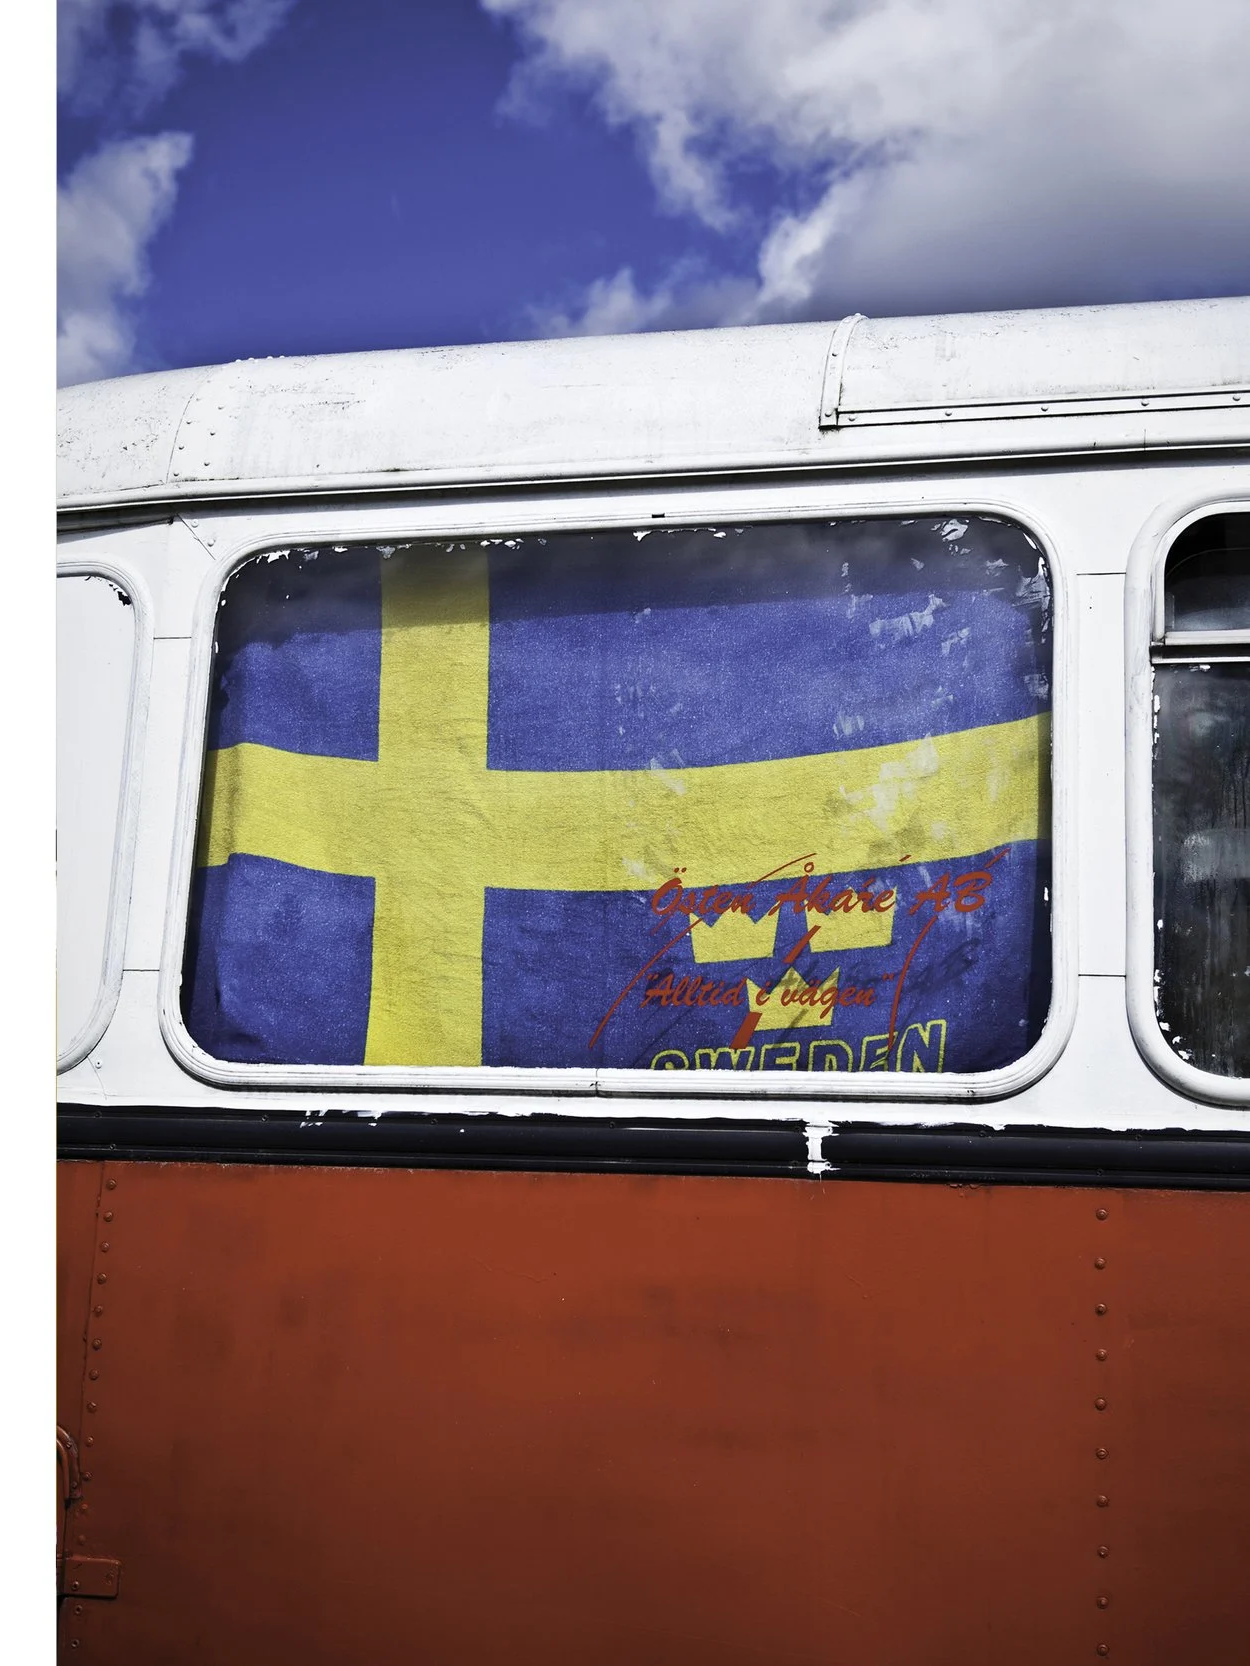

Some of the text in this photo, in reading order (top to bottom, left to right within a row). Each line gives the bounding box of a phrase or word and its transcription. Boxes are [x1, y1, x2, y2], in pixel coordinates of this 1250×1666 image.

[651, 867, 757, 916] Östen
[908, 870, 993, 916] AB
[755, 981, 771, 1007] i
